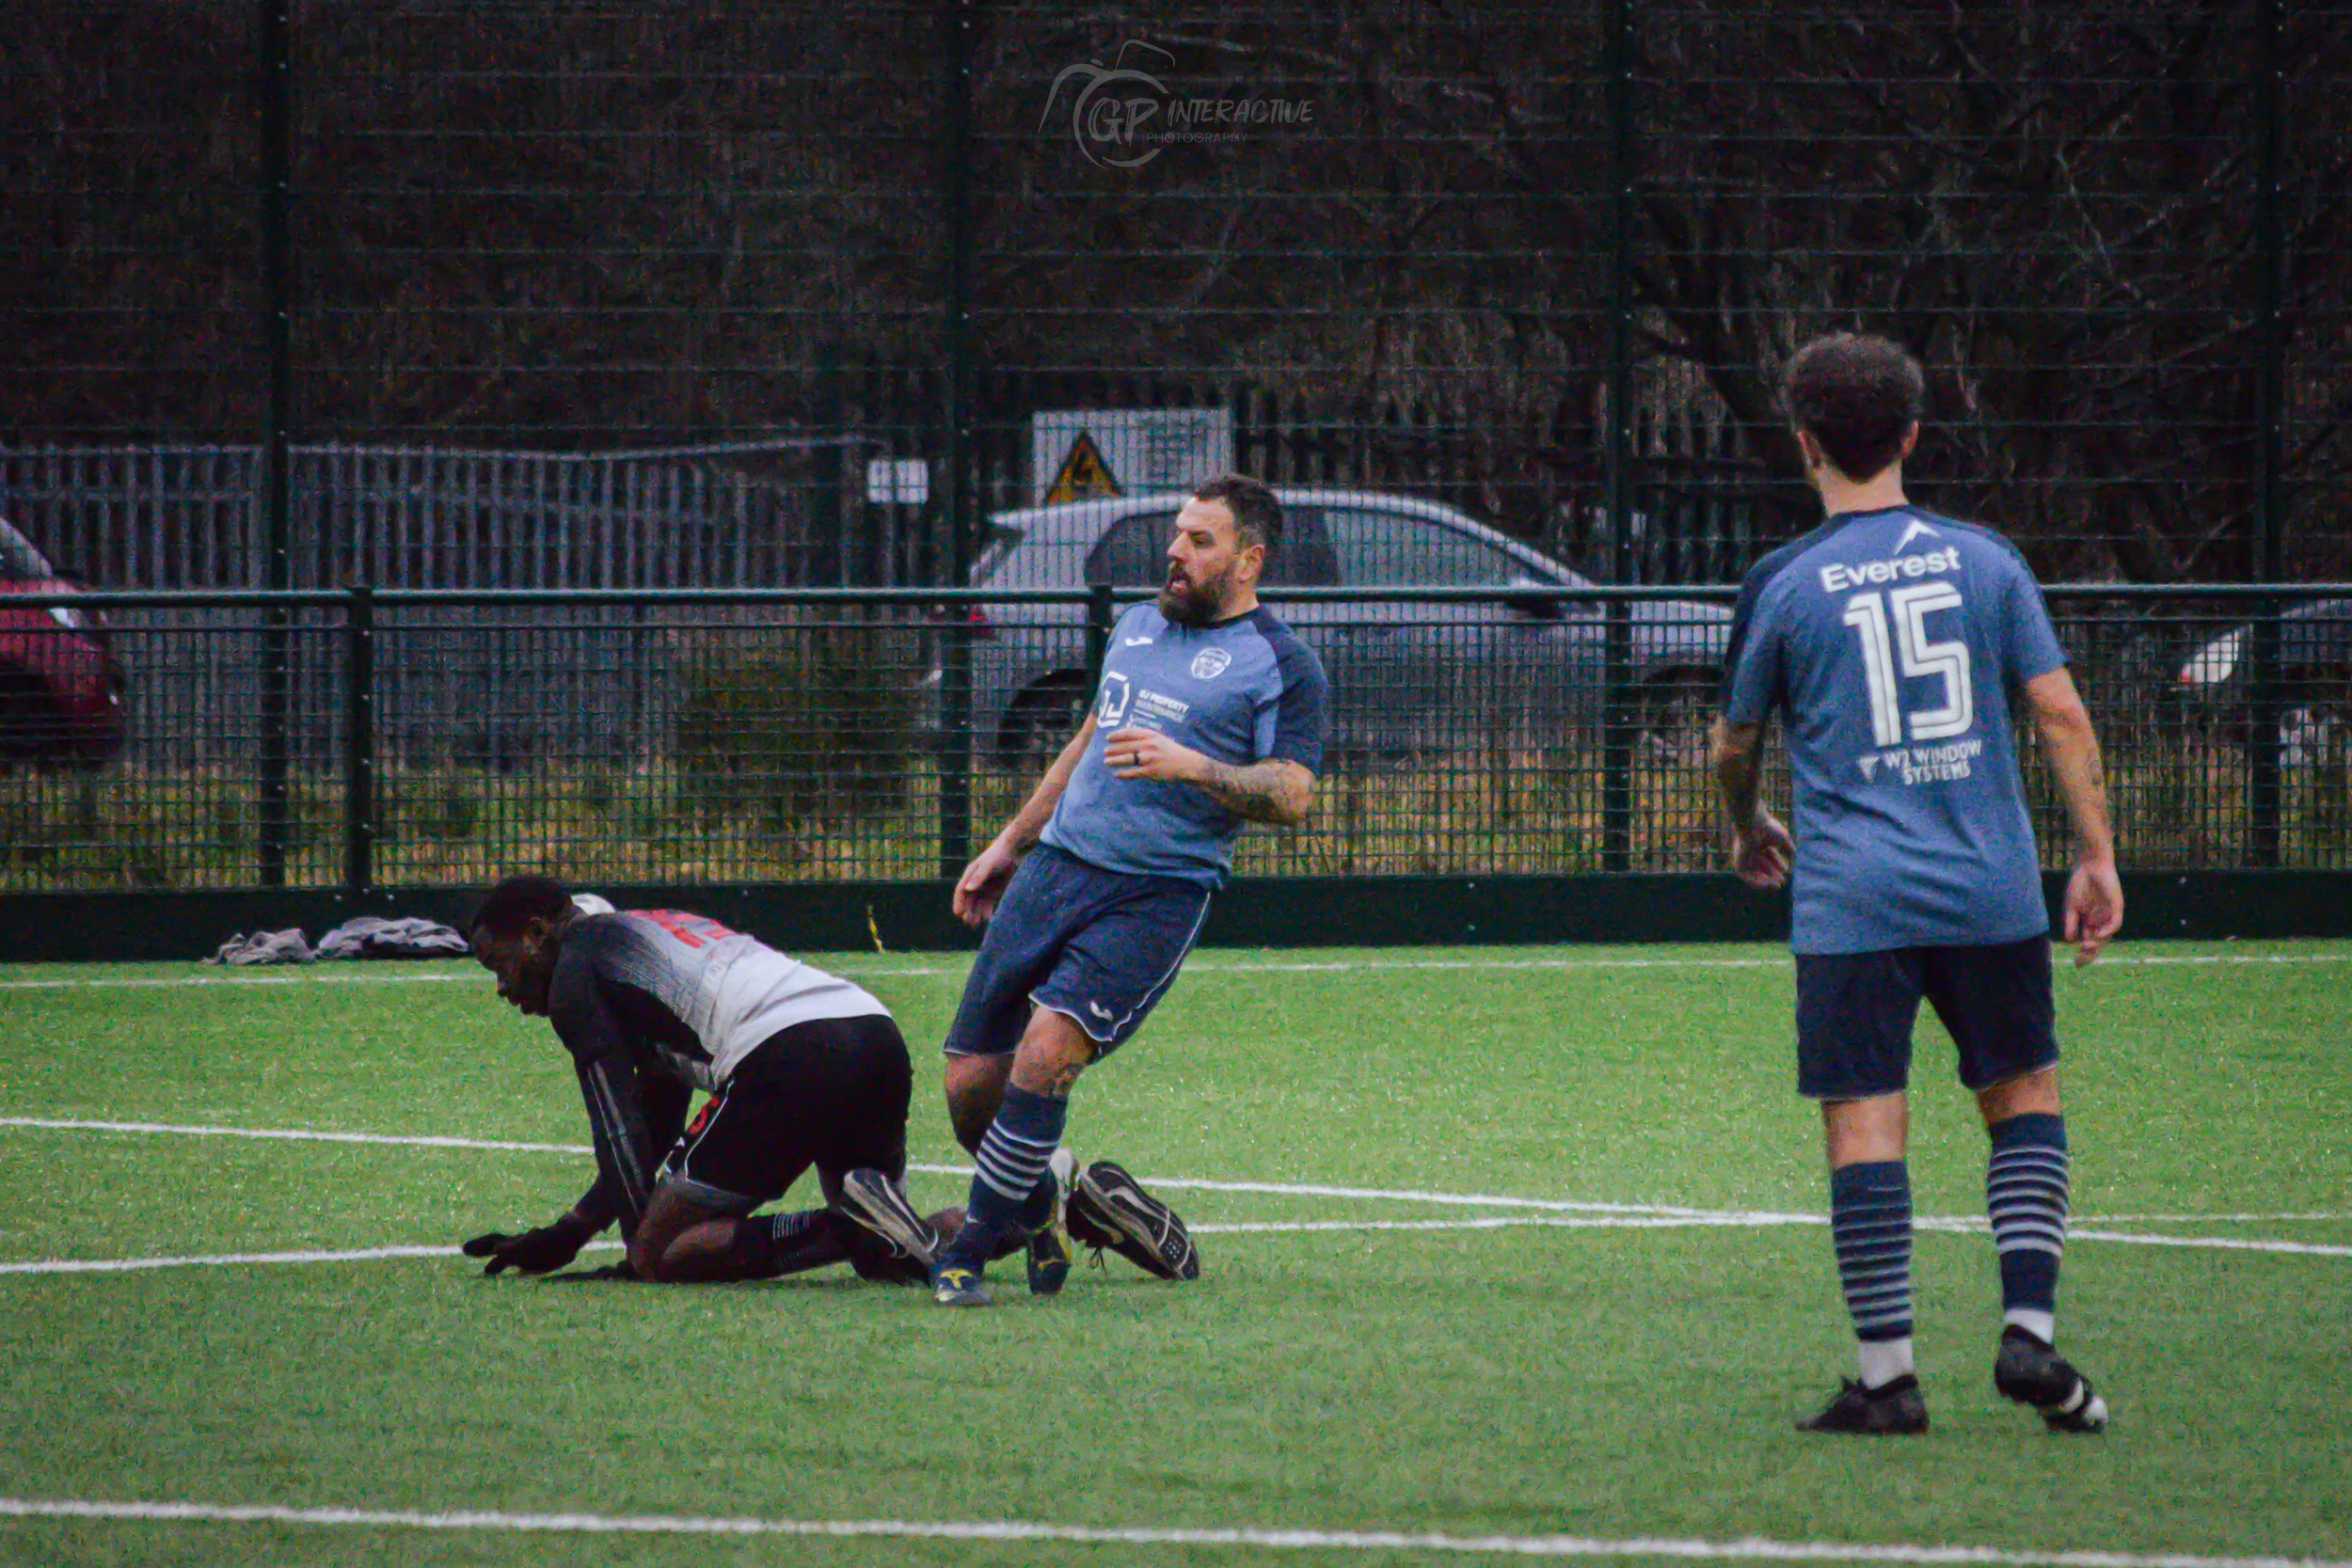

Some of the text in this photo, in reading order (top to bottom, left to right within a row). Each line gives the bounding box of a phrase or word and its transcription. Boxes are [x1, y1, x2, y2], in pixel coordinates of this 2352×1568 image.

[1821, 546, 1962, 593] Everest
[1843, 581, 1974, 747] 15
[1150, 693, 1189, 713] PROPERTY
[1914, 738, 1982, 766] WINDOW
[1903, 760, 1971, 784] SYSTEMS
